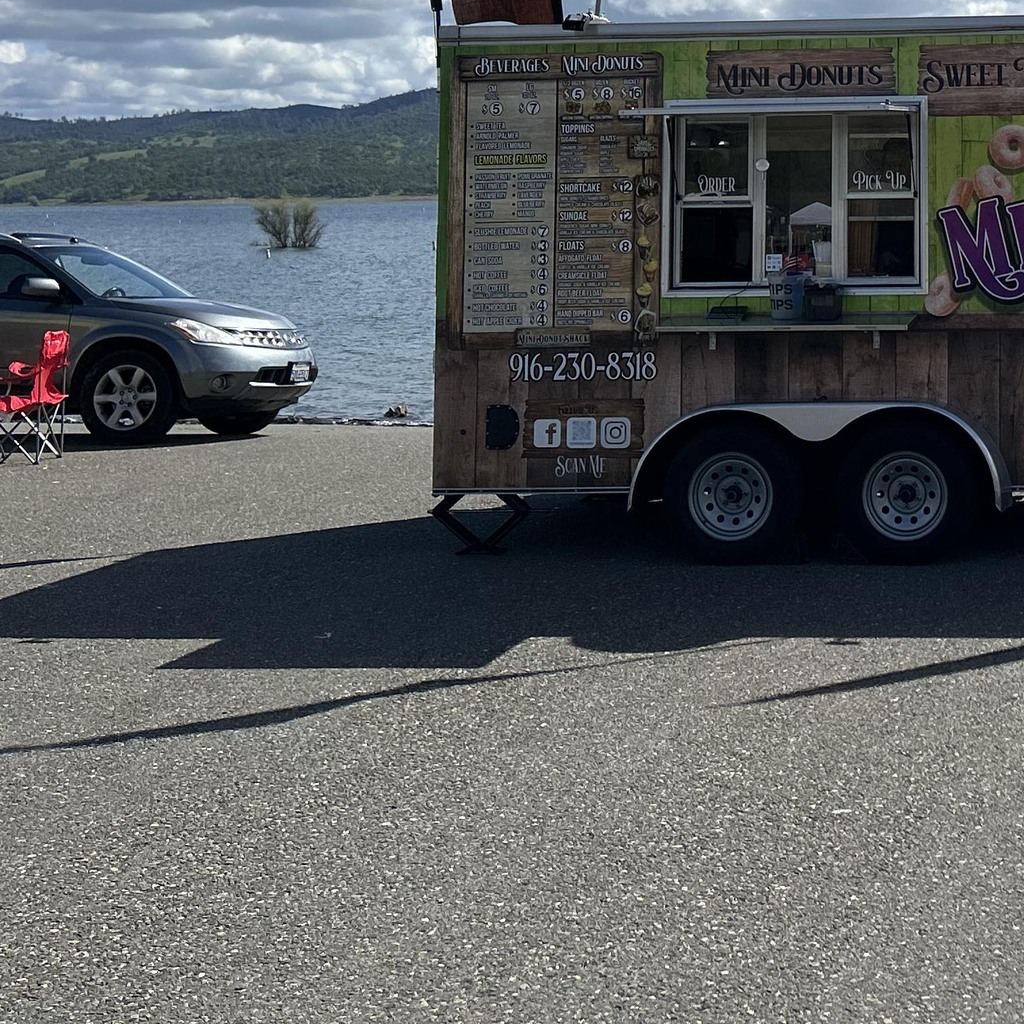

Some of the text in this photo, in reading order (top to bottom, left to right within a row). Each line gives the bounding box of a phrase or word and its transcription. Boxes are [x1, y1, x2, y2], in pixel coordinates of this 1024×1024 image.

[475, 57, 550, 77] BEVERAGES
[562, 54, 644, 76] MINI DONUTS
[716, 62, 884, 95] MINI DONUTS
[922, 59, 1008, 95] SWEET
[476, 122, 493, 130] SWEET
[561, 124, 595, 134] TOPPINGS
[475, 131, 519, 140] ARNOLD PALMER
[475, 141, 531, 150] FLAVORED LEMONADE
[474, 154, 547, 165] LEMONADE FLAVORS
[697, 174, 736, 193] ORDER
[852, 170, 907, 191] PICK UP
[560, 183, 601, 193] SHORTCAKE
[560, 211, 588, 221] SUNDAE
[474, 228, 497, 236] SLUSHIE
[498, 227, 528, 235] LEMONADE
[474, 243, 499, 251] BOTTLED
[500, 242, 520, 250] WATER
[558, 240, 585, 251] FLOATS
[474, 257, 486, 265] CAN
[487, 257, 503, 265] SODA
[558, 254, 584, 262] AFFOGATO
[487, 271, 508, 279] COFFEE
[591, 271, 607, 279] FLOAT
[488, 284, 509, 292] COFFEE
[557, 289, 571, 297] ROOT
[472, 304, 484, 312] HOT
[485, 303, 517, 311] CHOCOLATE
[572, 309, 591, 317] DIPPED
[485, 317, 504, 325] APPLE
[518, 334, 589, 345] MINI DONUT SHACK
[509, 352, 658, 382] 916-230-8318
[555, 454, 607, 478] SCAN ME
